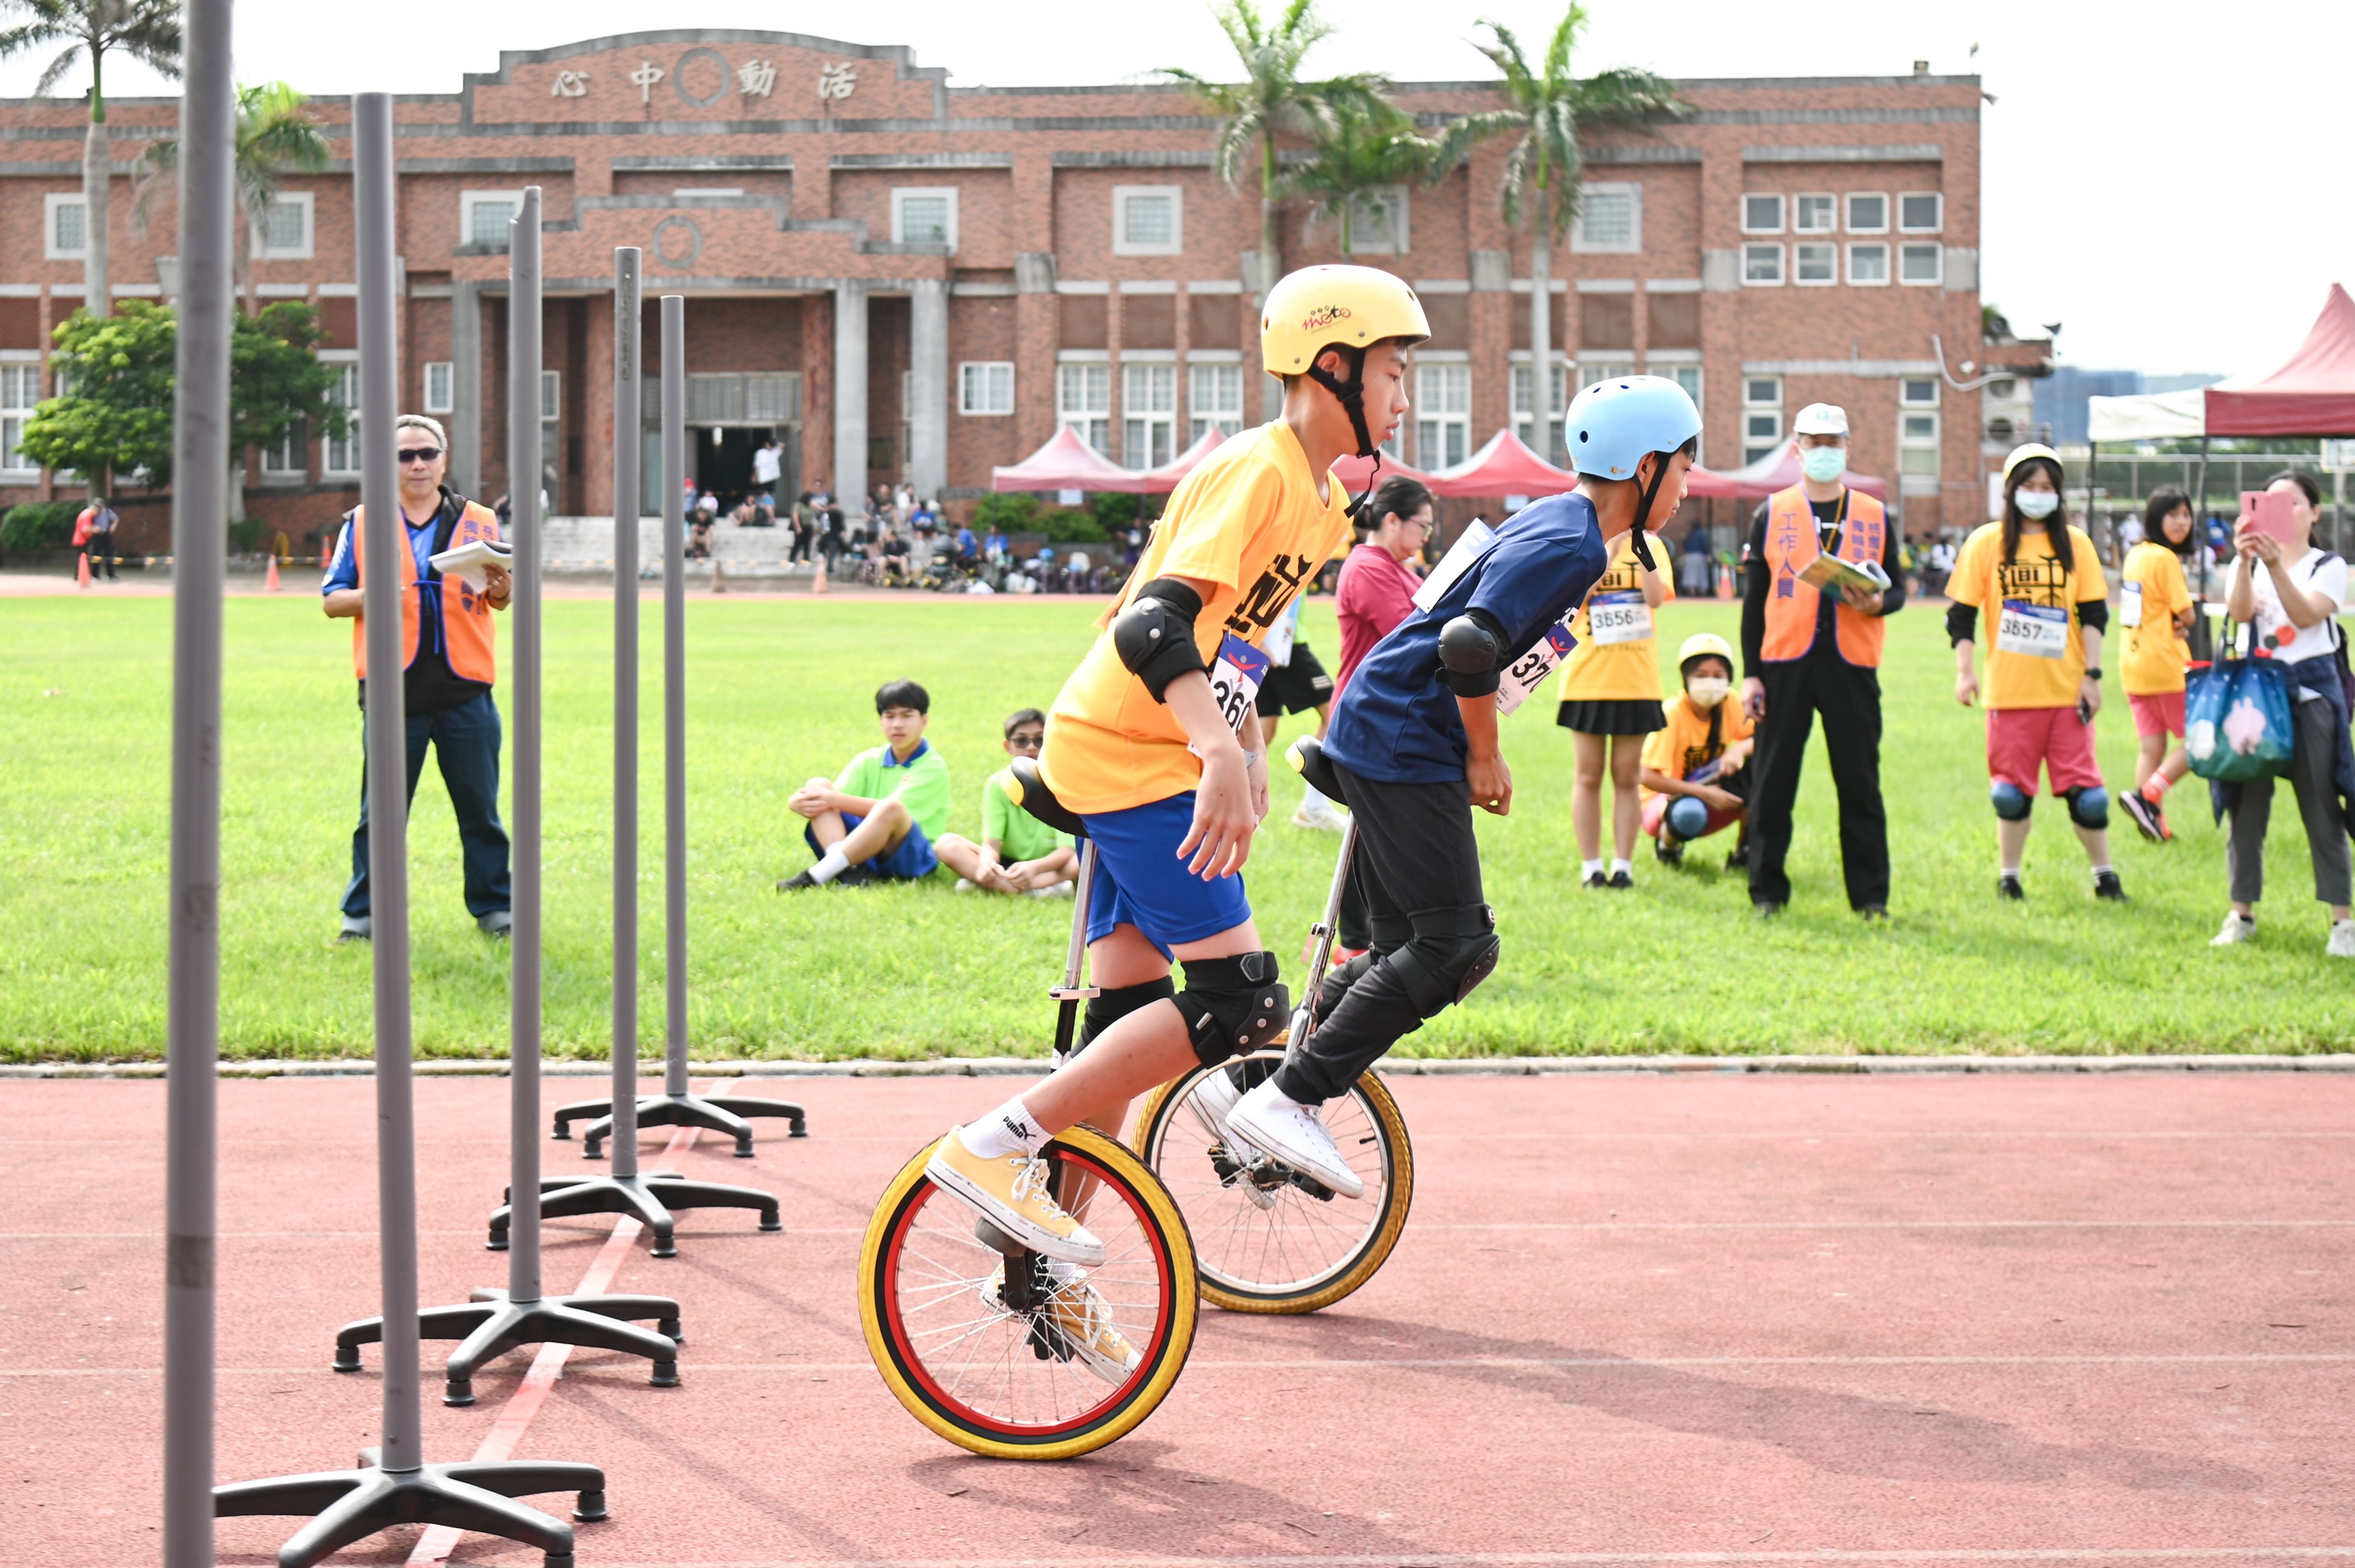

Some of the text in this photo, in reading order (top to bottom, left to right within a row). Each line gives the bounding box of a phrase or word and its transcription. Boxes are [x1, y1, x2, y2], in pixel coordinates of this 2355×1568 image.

[1778, 513, 1797, 598] 工作人員
[1594, 610, 1633, 628] 3656
[2002, 619, 2043, 640] 3657
[1002, 1116, 1024, 1138] PUMA
